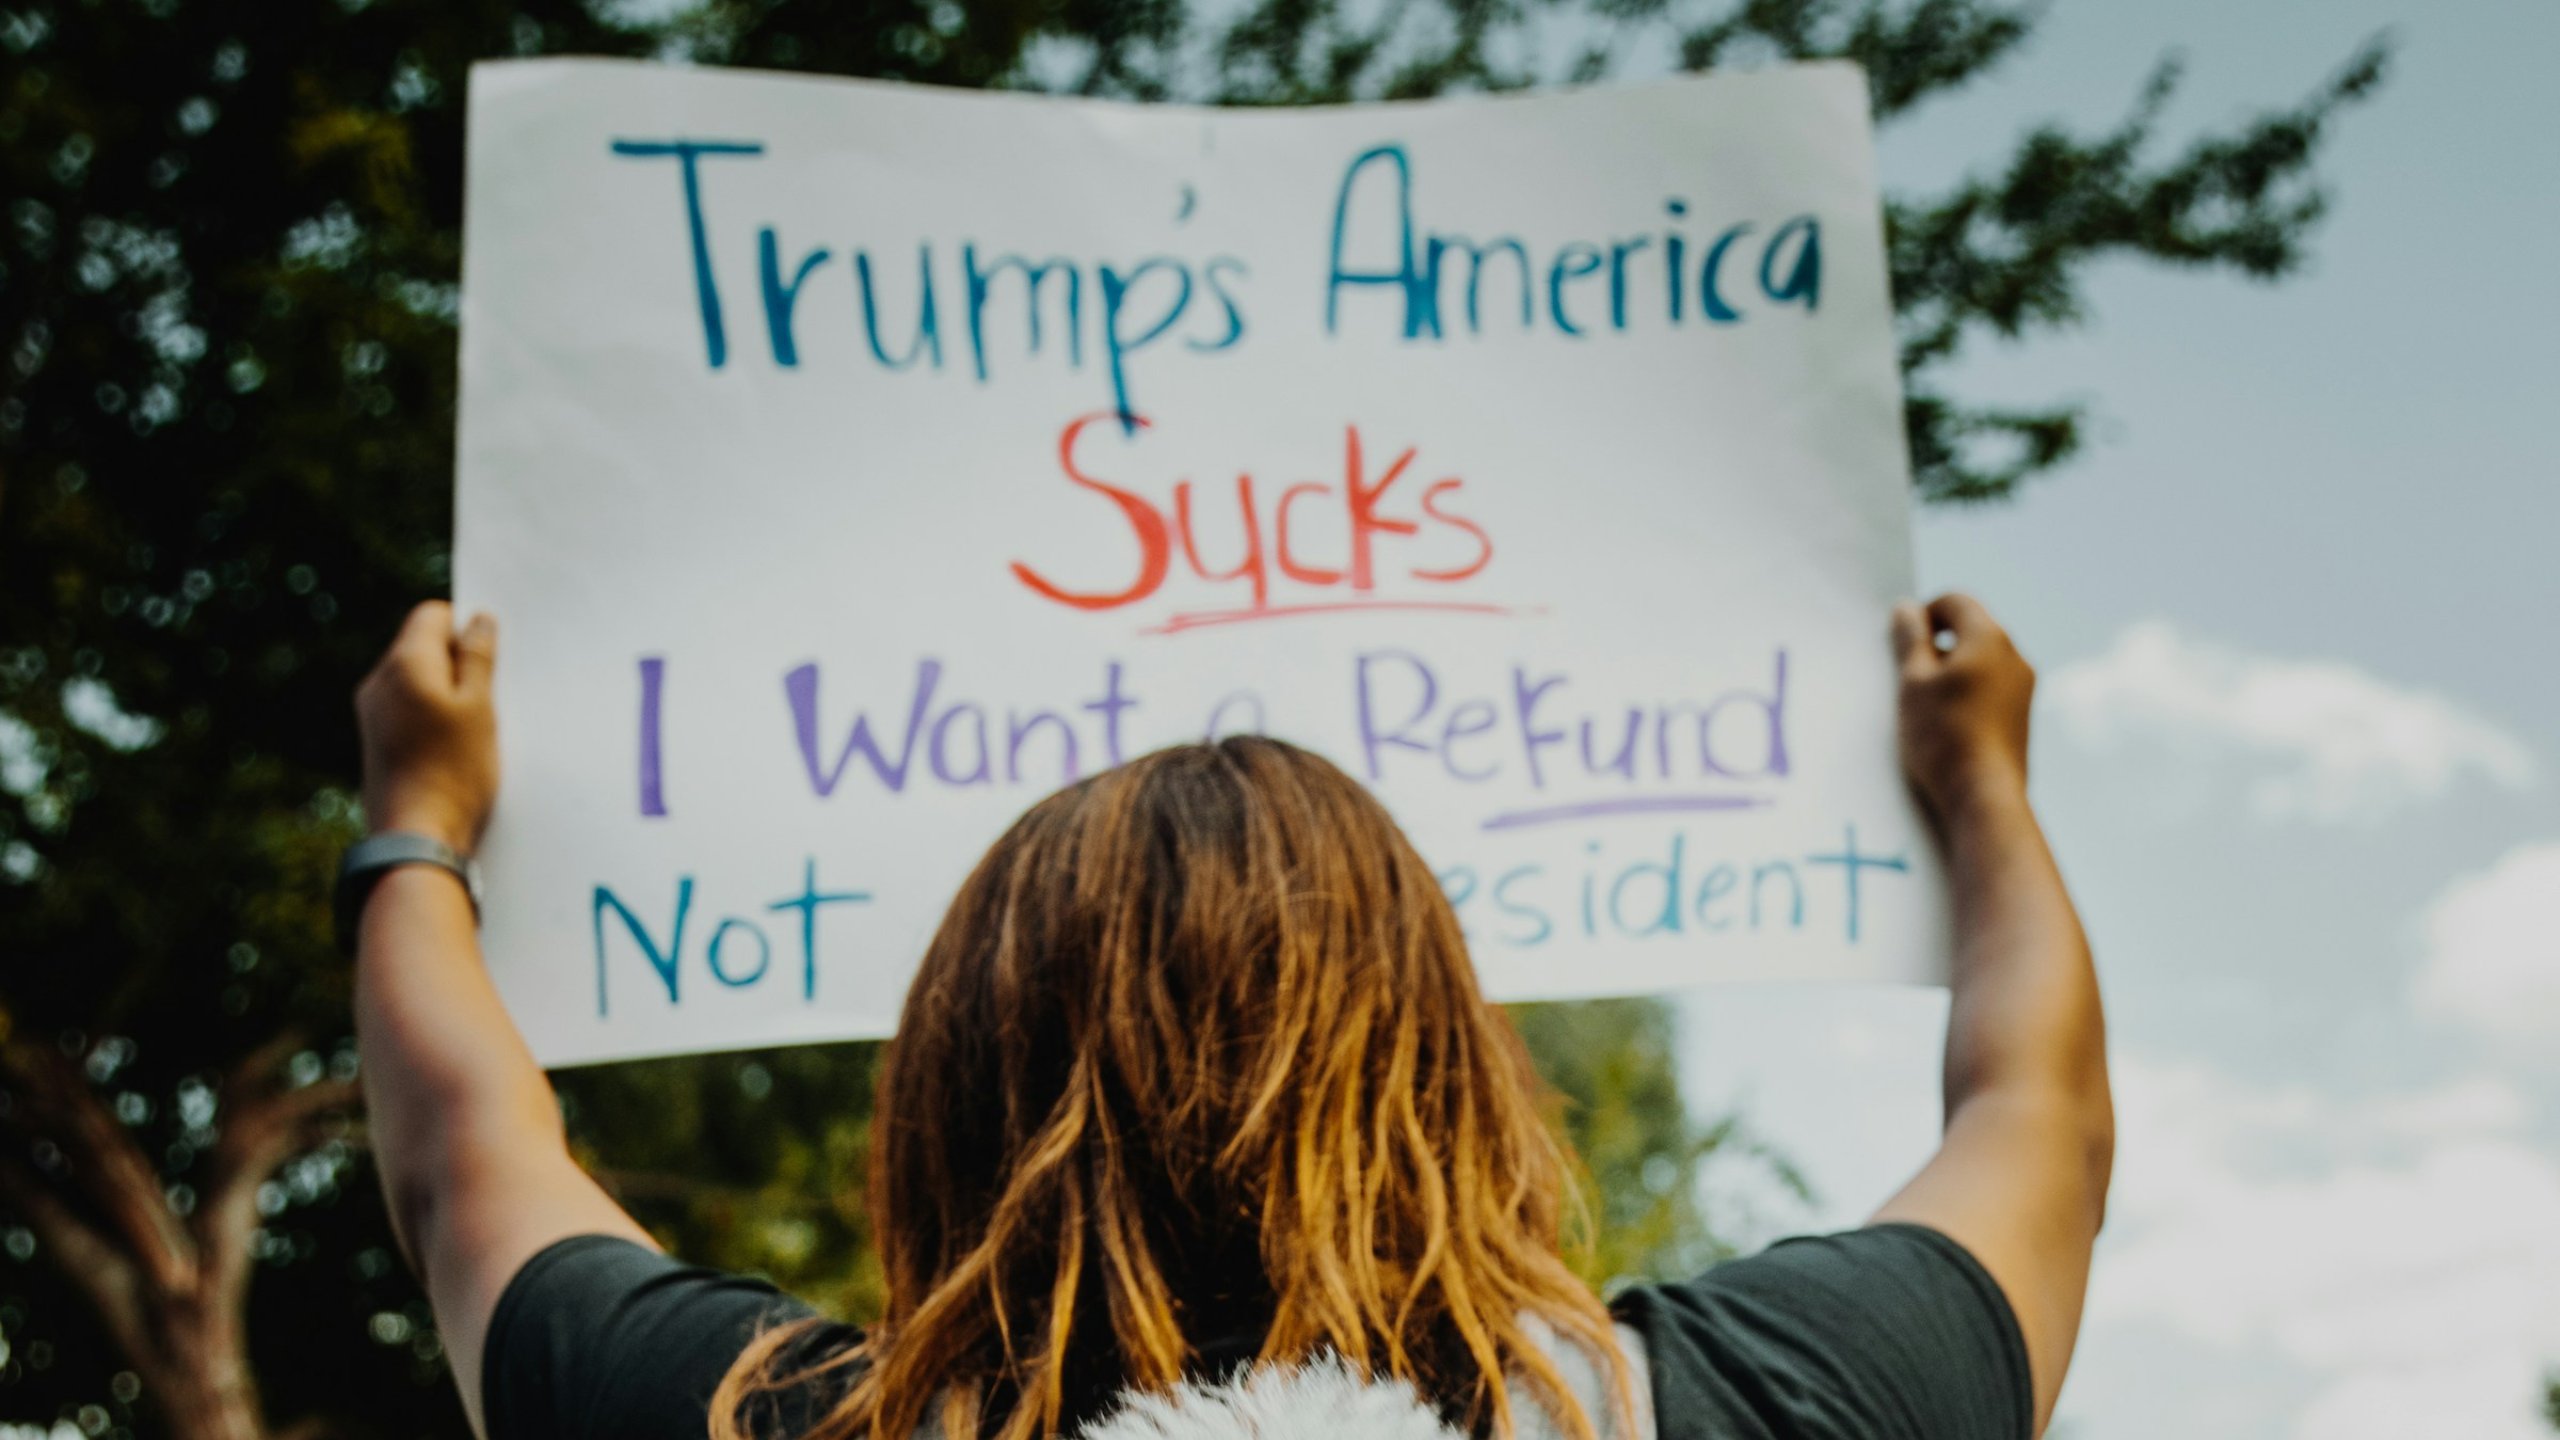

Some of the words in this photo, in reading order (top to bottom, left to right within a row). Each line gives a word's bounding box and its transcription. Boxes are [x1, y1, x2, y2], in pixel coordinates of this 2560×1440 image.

[609, 138, 1249, 438] Trump's
[1325, 142, 1822, 340] America
[1009, 410, 1493, 612] Sucks
[637, 657, 668, 817] I
[783, 657, 1140, 798] Want
[591, 857, 872, 1018] Not
[1438, 822, 1908, 947] esident
